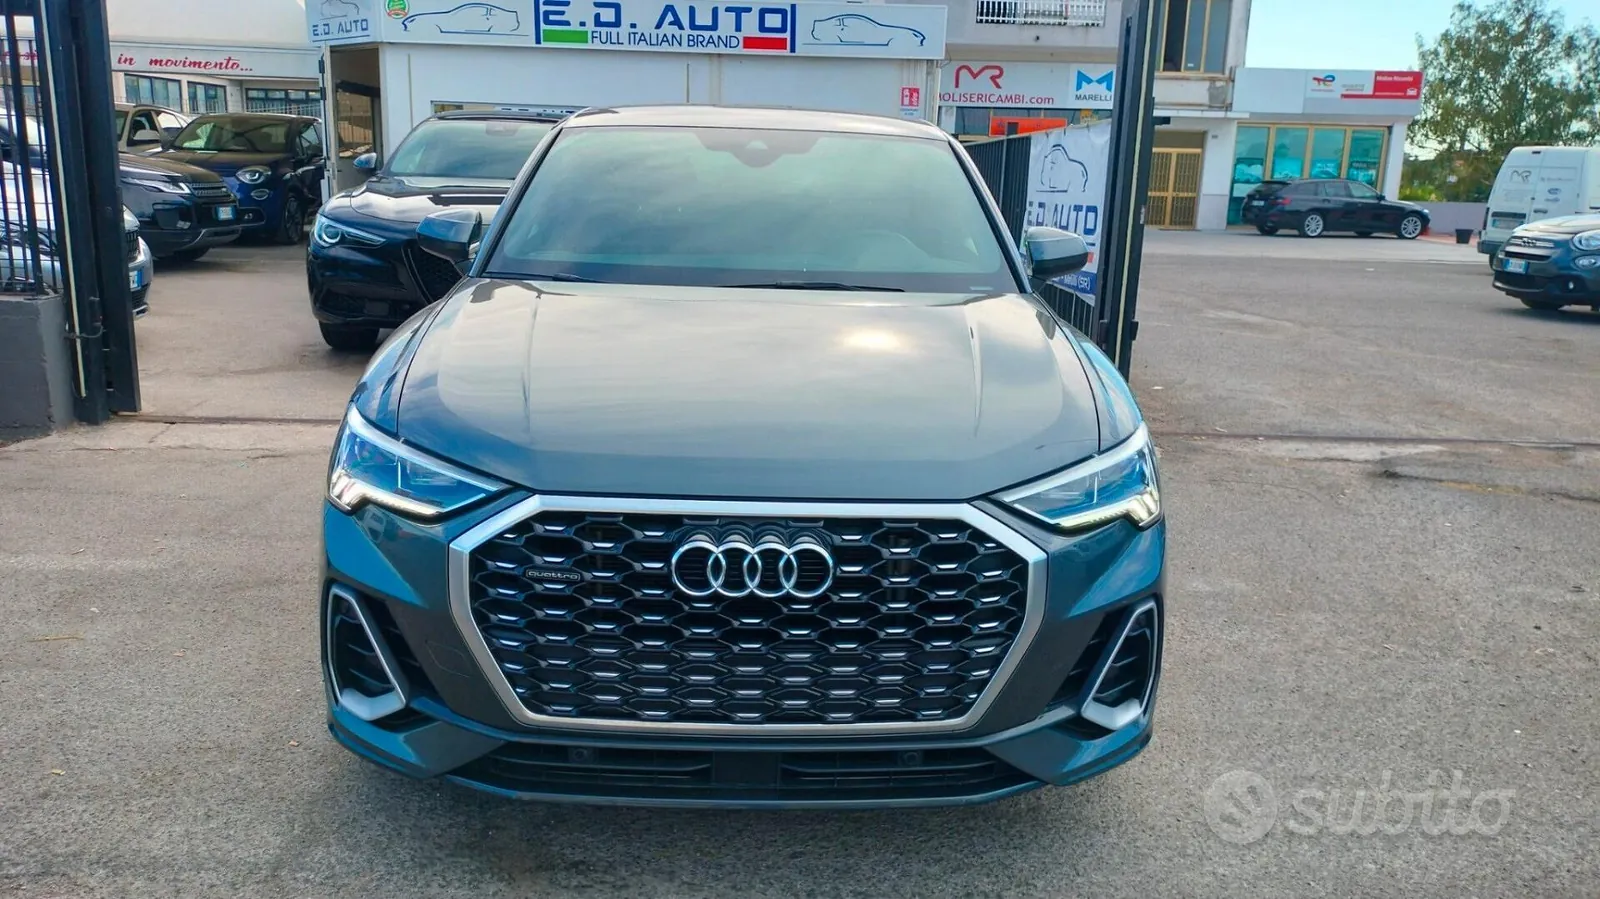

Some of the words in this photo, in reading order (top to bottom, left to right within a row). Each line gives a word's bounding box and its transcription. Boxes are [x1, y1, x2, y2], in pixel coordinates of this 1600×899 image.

[542, 0, 637, 28] E.D.
[654, 4, 788, 33] AUTO
[312, 23, 334, 37] E.D.
[338, 18, 369, 34] AUTO
[591, 30, 624, 45] FULL
[628, 32, 683, 47] ITALIAN
[687, 34, 740, 49] BRAND
[117, 53, 136, 66] in
[1051, 203, 1098, 236] AUTO
[528, 571, 578, 580] quattro
